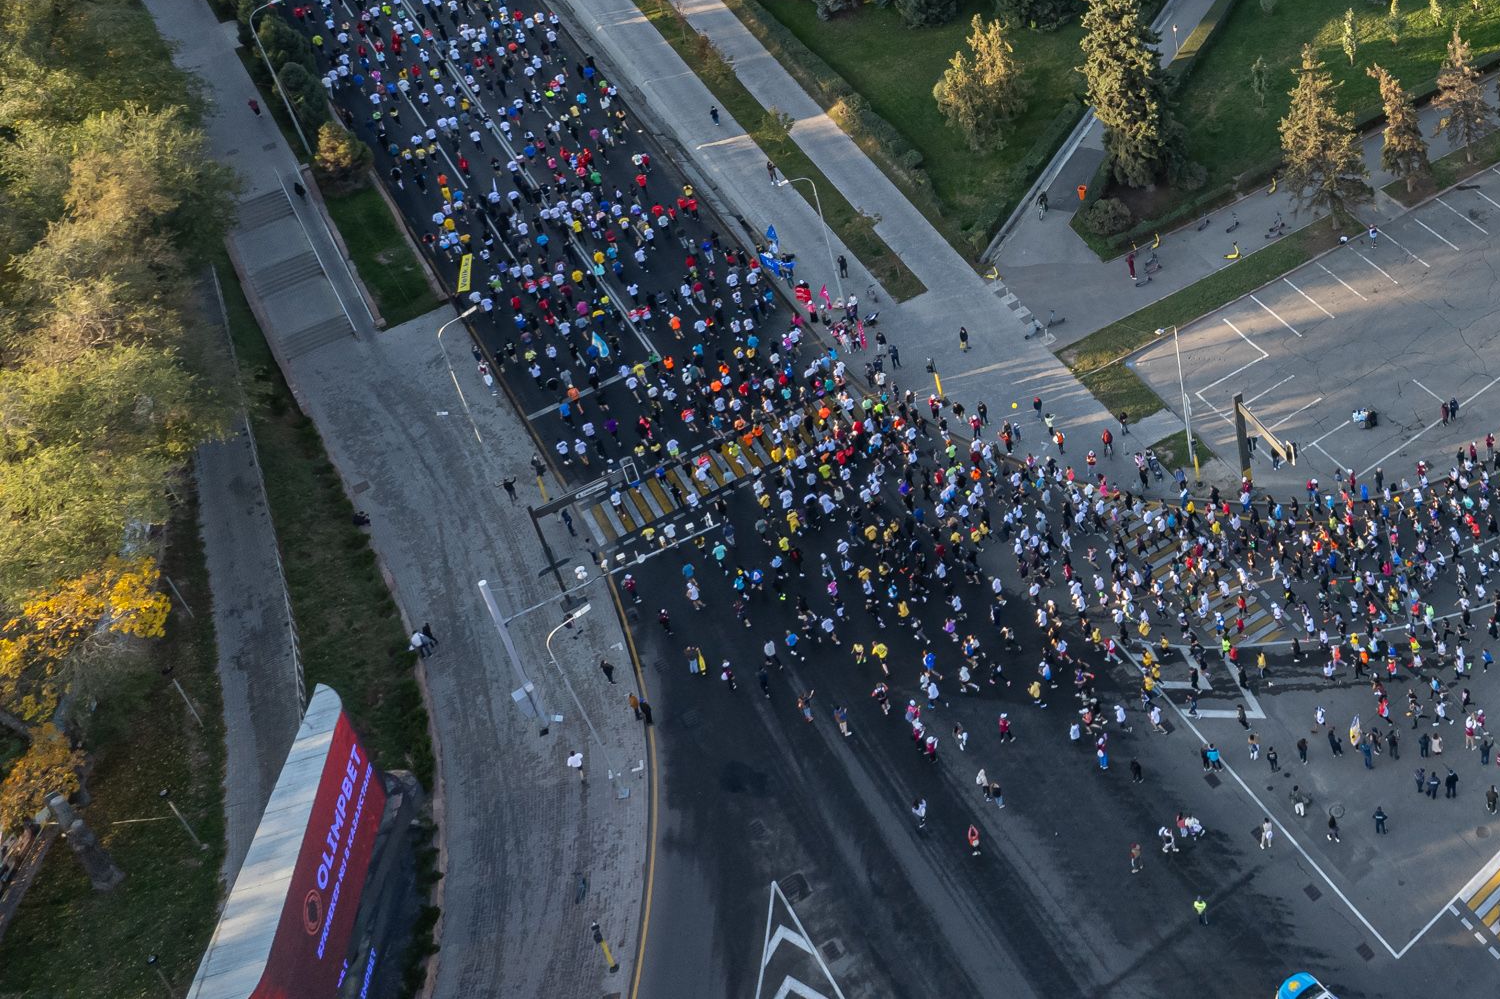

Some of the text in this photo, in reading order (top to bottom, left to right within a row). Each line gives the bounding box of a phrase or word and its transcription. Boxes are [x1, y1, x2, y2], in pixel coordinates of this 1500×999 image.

[316, 744, 362, 891] OLIMPBET
[316, 879, 343, 960] БУКМЕКЕР
[346, 762, 374, 850] КАЗАХСТАНЕ
